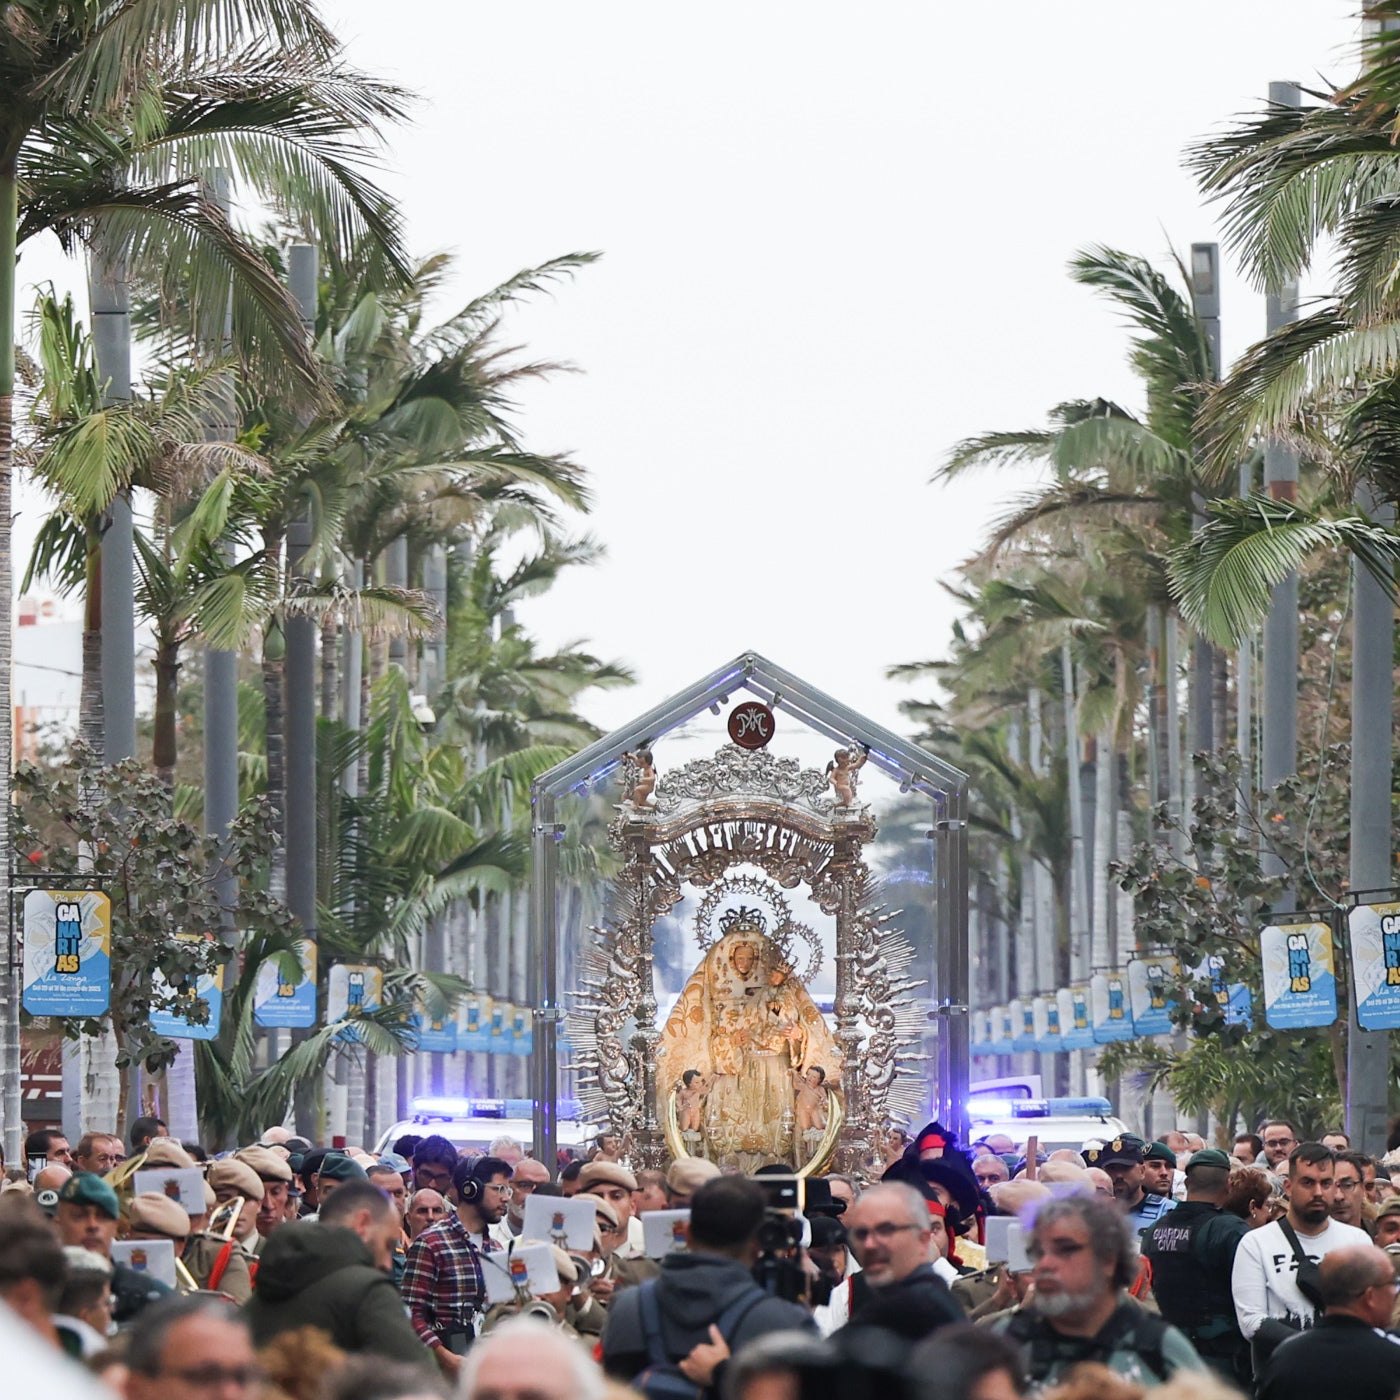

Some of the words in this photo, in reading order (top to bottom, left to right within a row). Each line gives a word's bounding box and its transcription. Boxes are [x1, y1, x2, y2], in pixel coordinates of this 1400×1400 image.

[58, 904, 80, 922] CA
[58, 922, 80, 938] NA
[58, 938, 78, 954] RI
[1288, 935, 1308, 950] CA
[56, 954, 78, 972] AS
[1290, 950, 1310, 964] NA
[1292, 976, 1310, 992] AS
[1152, 1227, 1190, 1240] GUARDIA
[1157, 1240, 1177, 1252] CIVIL
